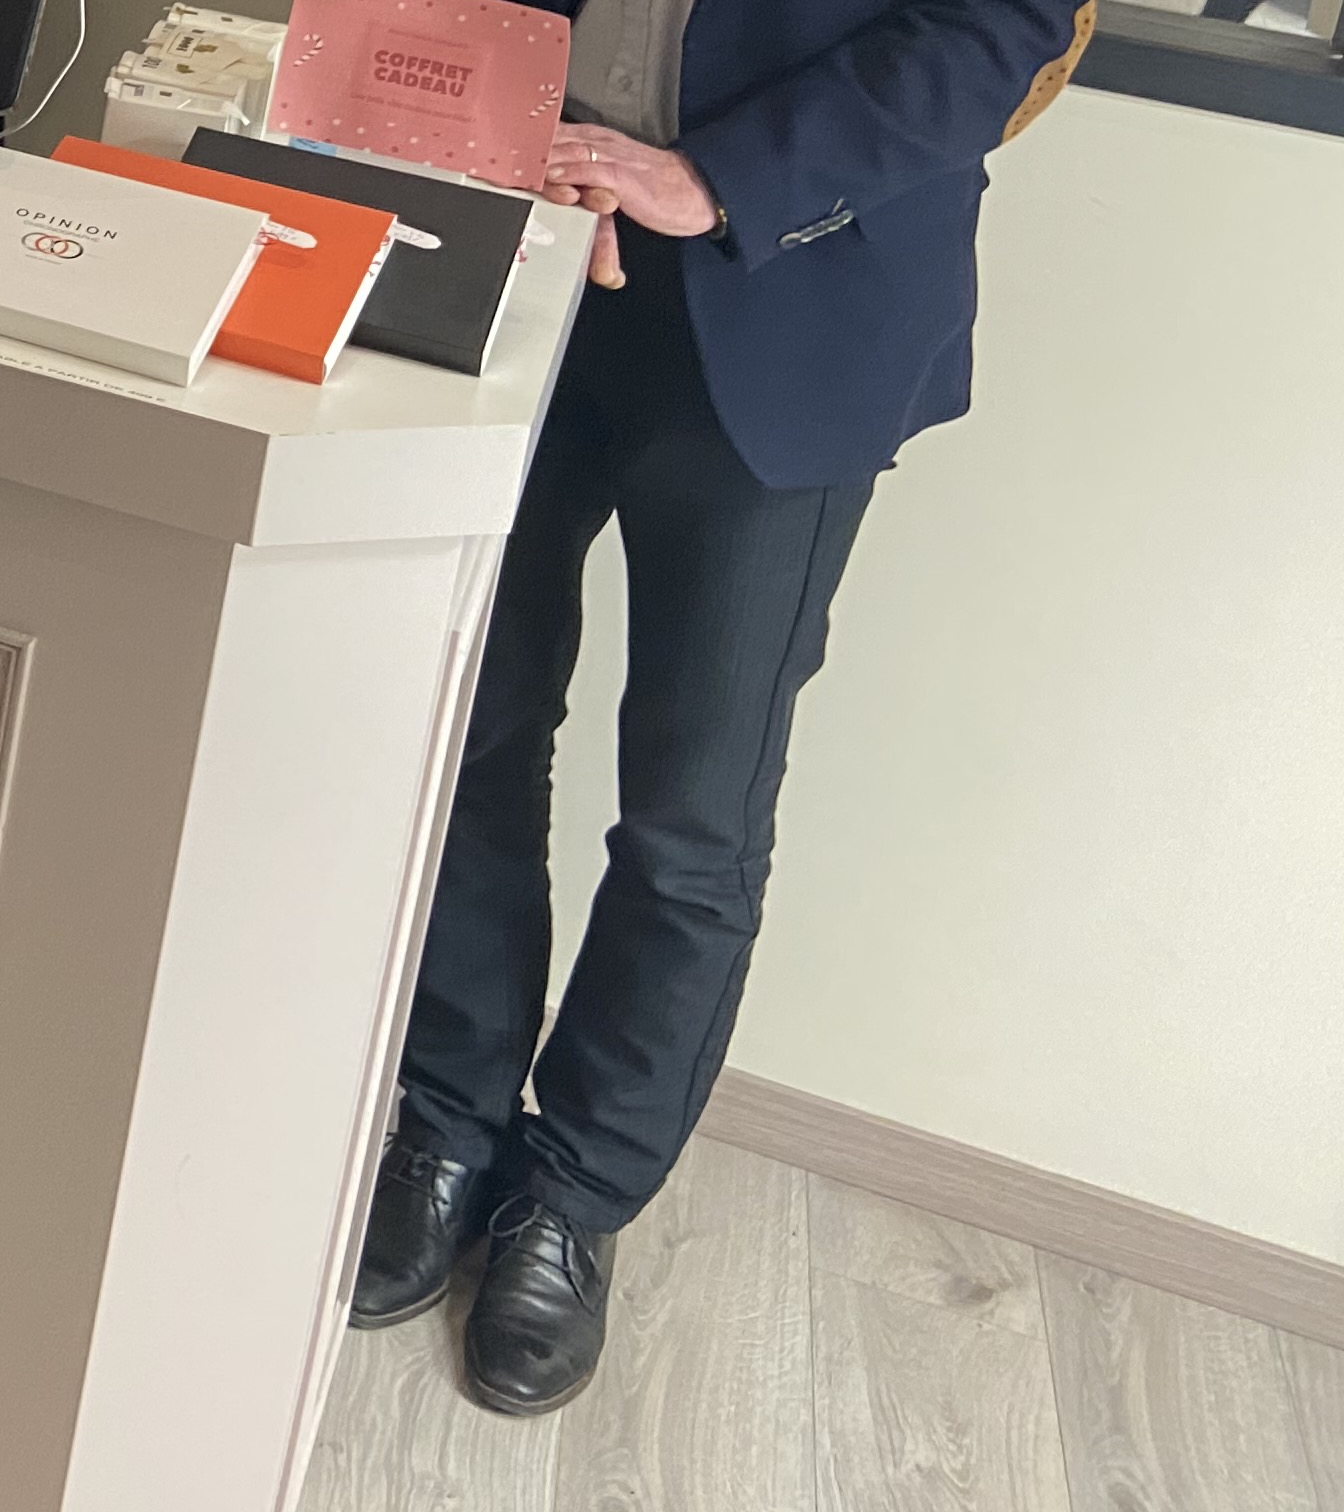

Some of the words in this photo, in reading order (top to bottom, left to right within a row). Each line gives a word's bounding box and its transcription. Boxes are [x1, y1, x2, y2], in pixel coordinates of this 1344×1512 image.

[374, 49, 473, 82] COFFRET
[373, 67, 465, 98] CADEAU
[16, 208, 118, 239] OPINION
